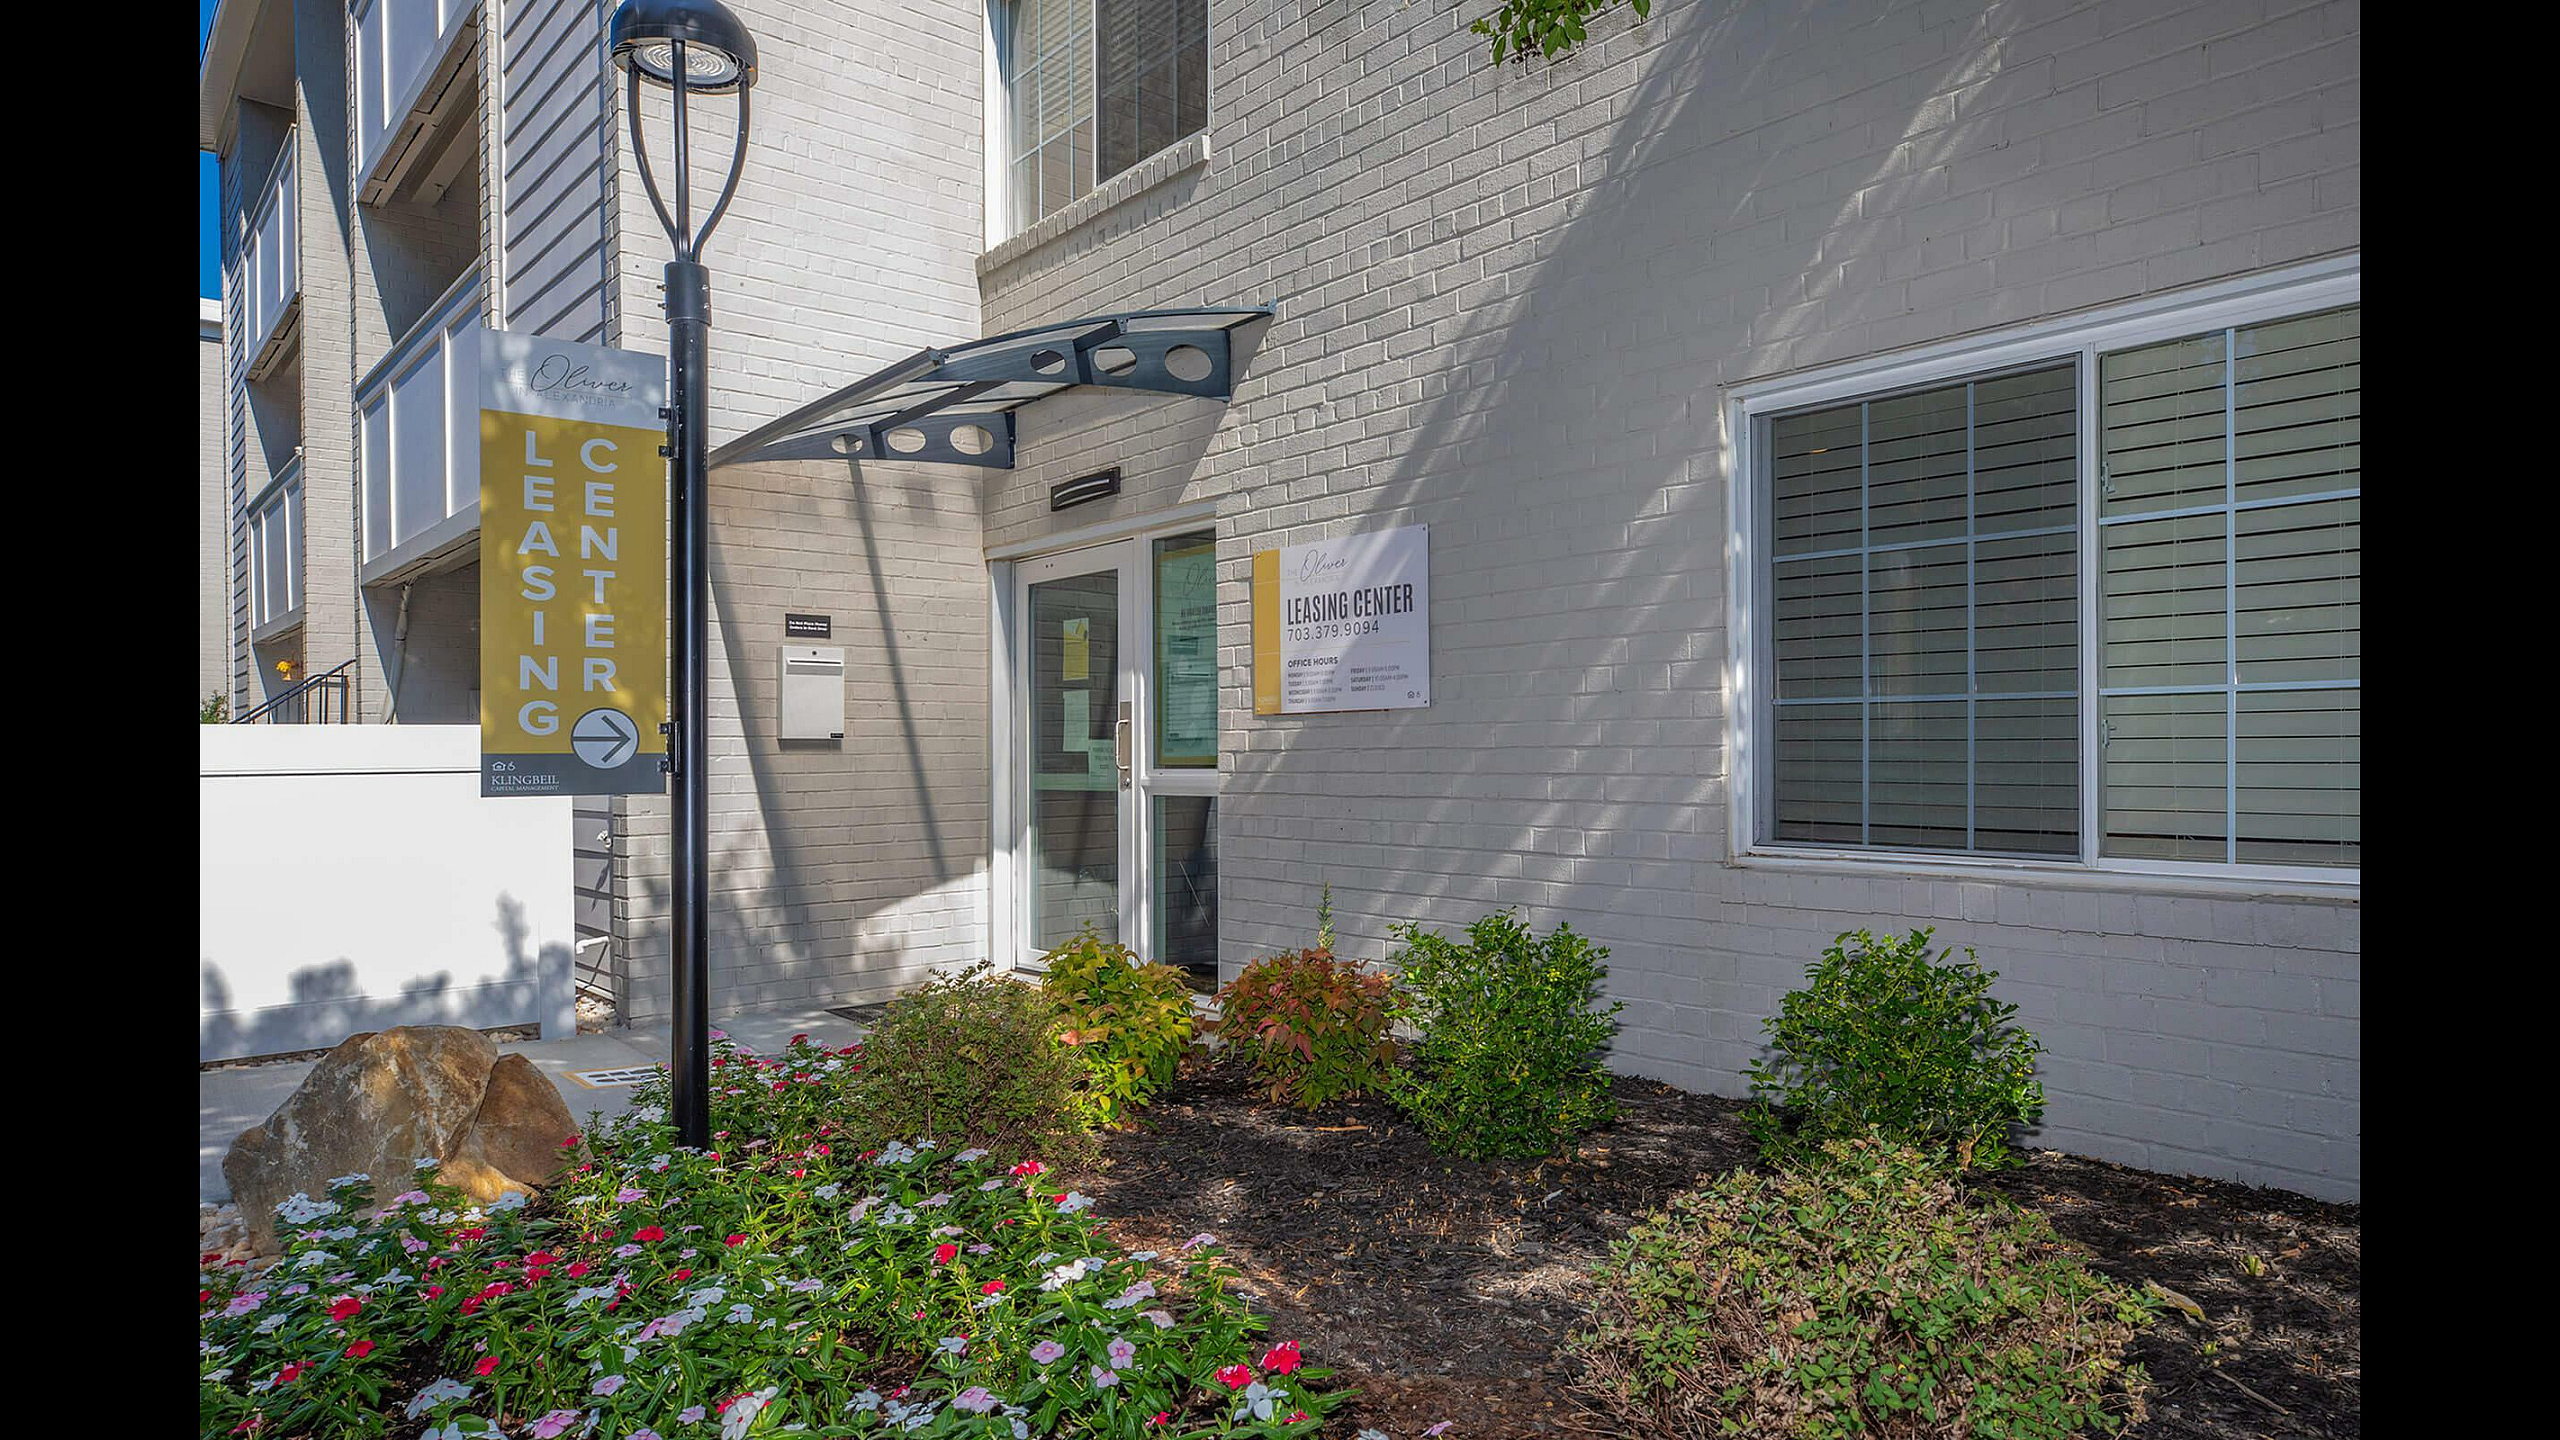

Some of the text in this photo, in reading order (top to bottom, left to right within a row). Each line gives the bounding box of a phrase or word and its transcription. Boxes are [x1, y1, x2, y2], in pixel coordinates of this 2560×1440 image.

[530, 353, 633, 393] Oliver
[580, 437, 619, 692] CENTER
[1300, 548, 1348, 582] Oliver
[516, 429, 561, 736] LEASING
[1287, 583, 1414, 626] LEASING CENTER
[1287, 620, 1380, 642] 703.379.9094
[1287, 656, 1339, 668] OFFICE HOURS
[491, 774, 560, 785] KLINGBEIL
[516, 784, 560, 792] MANAGEMENT
